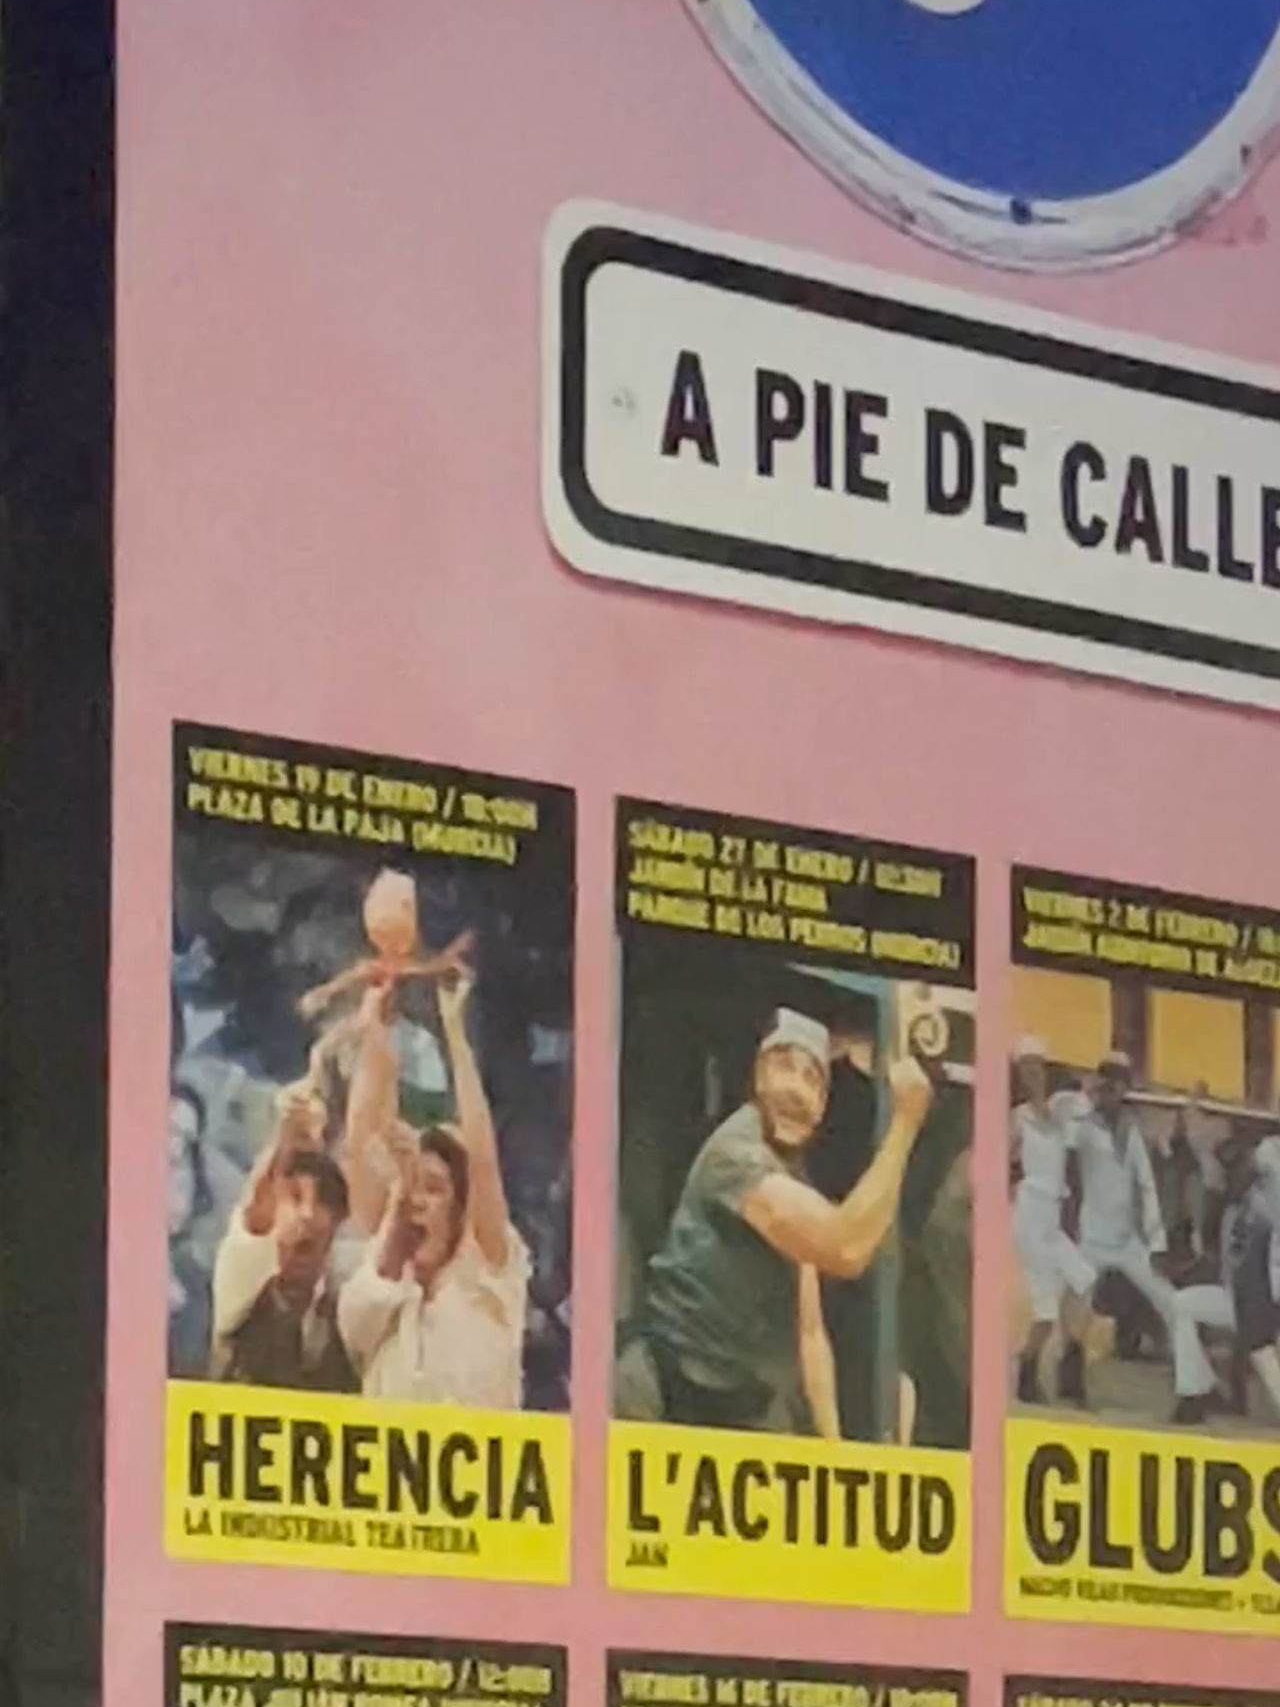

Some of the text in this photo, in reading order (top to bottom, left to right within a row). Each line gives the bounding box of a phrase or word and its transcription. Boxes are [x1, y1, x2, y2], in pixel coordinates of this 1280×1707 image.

[661, 351, 720, 467] A
[754, 367, 890, 503] PIE
[924, 406, 1028, 535] DE
[188, 747, 287, 788] VIERNES
[326, 769, 356, 800] DE
[363, 775, 437, 813] ENERO
[188, 784, 516, 865] PLAZA DE LA PAJA (MURCIA)
[188, 1411, 554, 1525] HERENCIA
[628, 1449, 955, 1555] L'ACTITUD
[184, 1507, 213, 1538] LA
[221, 1511, 356, 1548] INDUSTRIAL
[180, 1639, 275, 1676] SÁBADO
[314, 1653, 345, 1683] DE
